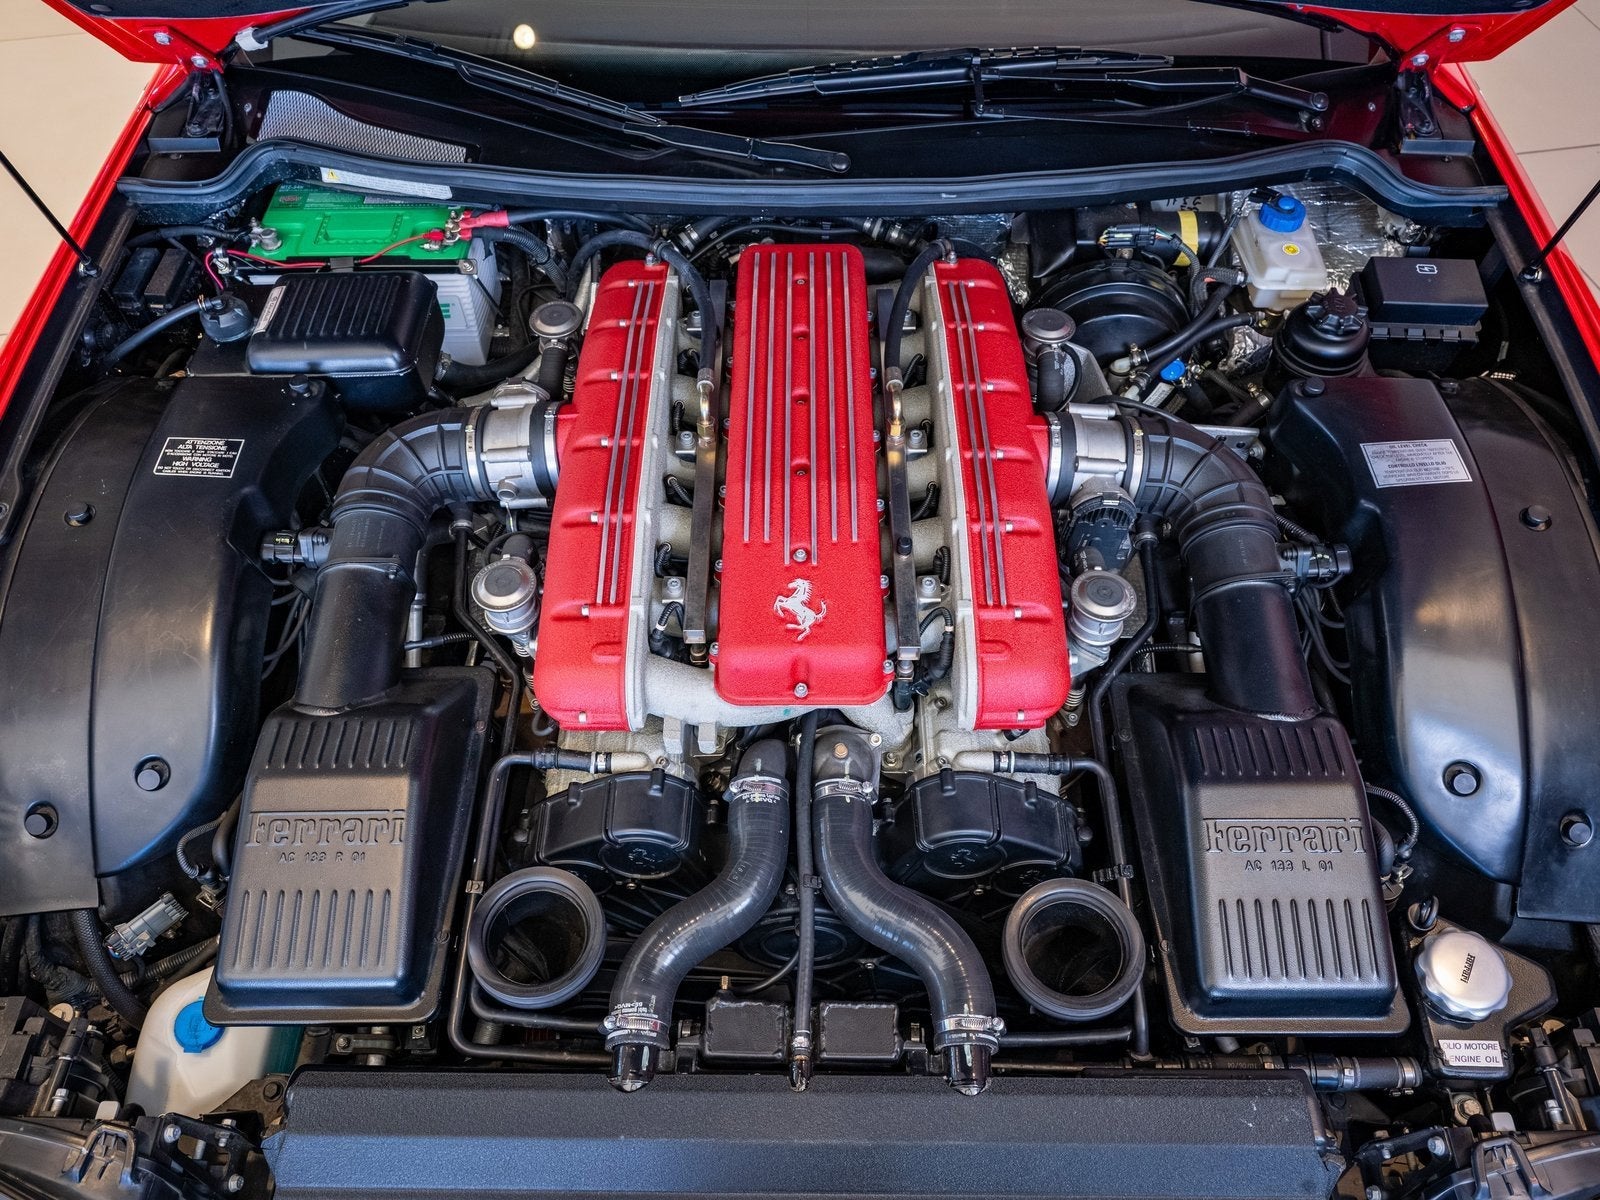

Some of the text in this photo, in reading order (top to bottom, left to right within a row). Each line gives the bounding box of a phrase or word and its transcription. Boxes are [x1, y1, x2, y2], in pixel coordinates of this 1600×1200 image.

[245, 809, 406, 847] Ferrari
[1203, 817, 1367, 853] Ferrari
[278, 851, 296, 864] AC
[335, 851, 344, 863] R
[351, 851, 366, 863] 01
[1245, 860, 1334, 871] AC 133 L 01
[1460, 952, 1476, 984] Ferrari
[1443, 1042, 1499, 1051] OLIO MOTORE
[1450, 1055, 1500, 1064] ENGINE OIL
